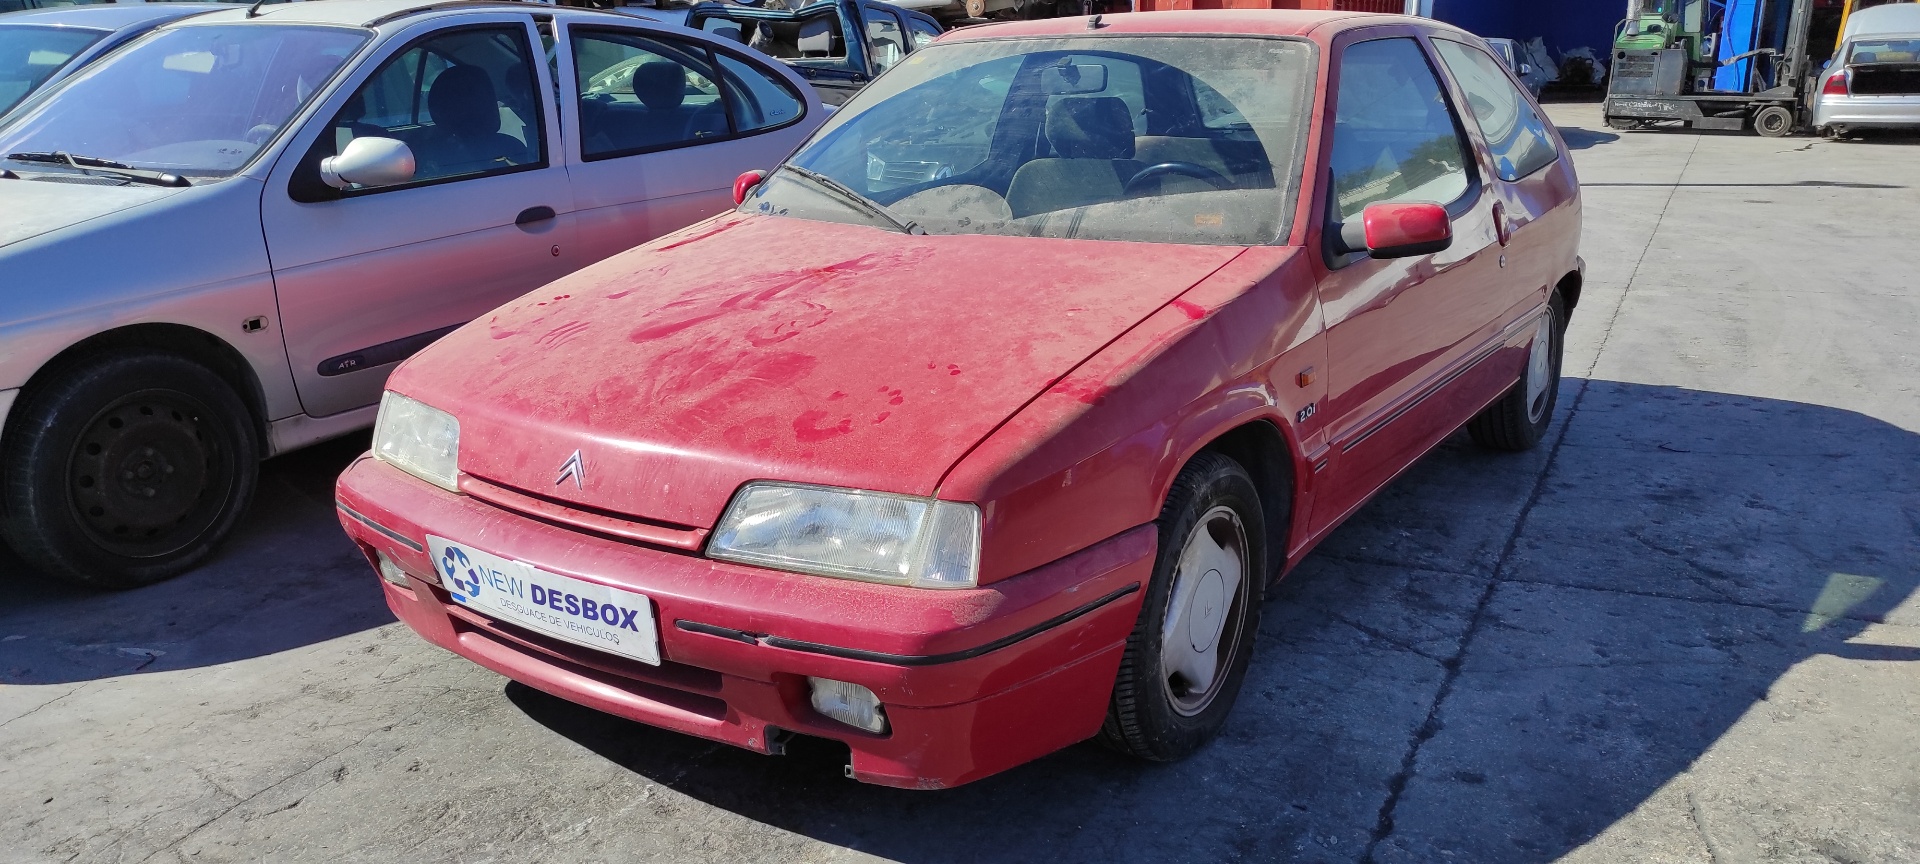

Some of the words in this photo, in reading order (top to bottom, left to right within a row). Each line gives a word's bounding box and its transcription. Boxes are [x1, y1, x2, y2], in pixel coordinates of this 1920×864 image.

[478, 564, 524, 599] NEW
[530, 583, 639, 632] DESBOX
[499, 597, 548, 622] DESGUACE
[548, 614, 562, 627] DE
[563, 619, 620, 646] VEHICULOS
